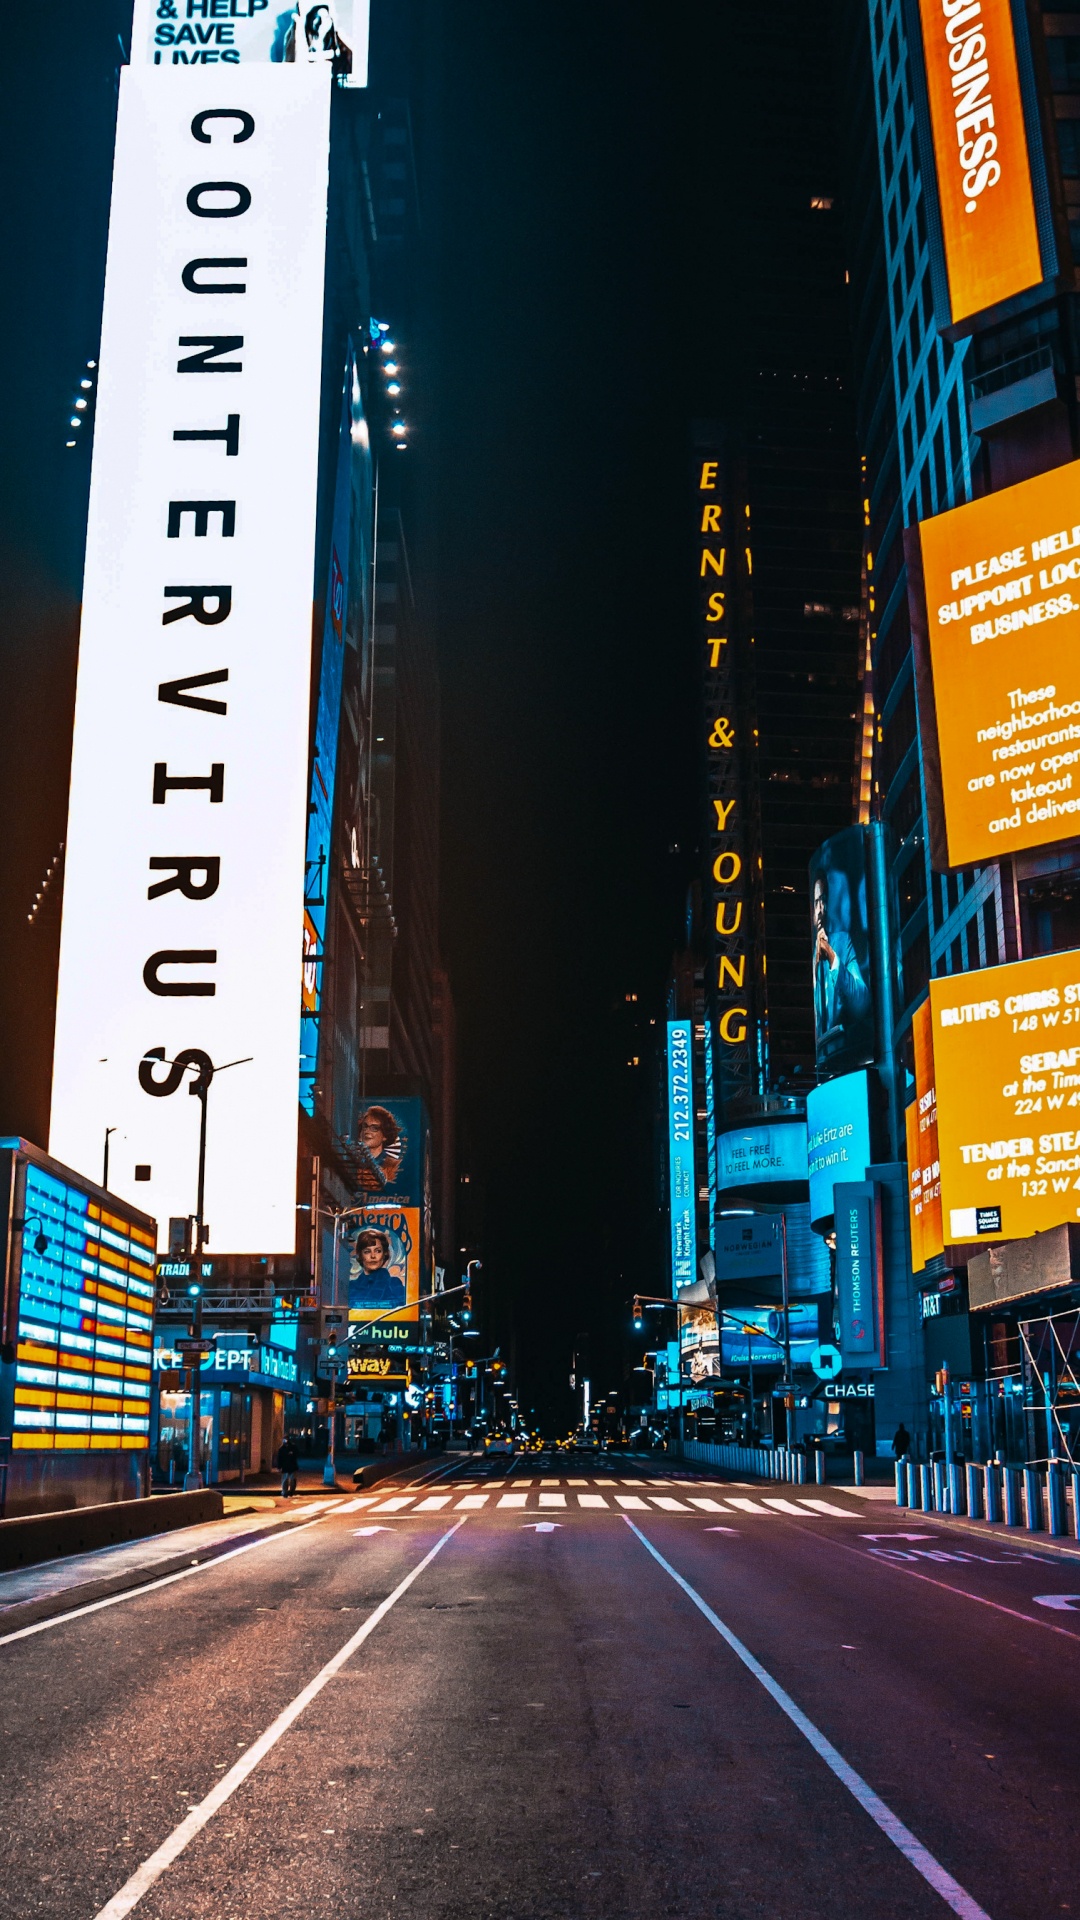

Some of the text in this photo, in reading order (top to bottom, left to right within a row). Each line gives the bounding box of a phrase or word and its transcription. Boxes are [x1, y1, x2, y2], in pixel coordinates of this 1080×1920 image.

[156, 0, 269, 19] & HELP
[154, 23, 235, 46] SAVE
[951, 546, 1027, 590] PLEASE
[938, 574, 1034, 625] SUPPORT
[970, 593, 1080, 645] BUSINESS.
[1007, 685, 1056, 709] These
[699, 462, 748, 1043] ERNST & YOUNG
[992, 723, 1080, 762] restaurants
[967, 774, 995, 792] are
[999, 761, 1036, 783] now
[1010, 773, 1072, 803] takeout
[988, 807, 1022, 833] and
[1012, 1014, 1038, 1033] 148
[1041, 1010, 1060, 1028] W
[672, 1029, 690, 1141] 212.372.2349
[1002, 1080, 1019, 1097] at
[1022, 1075, 1046, 1094] the
[1014, 1096, 1042, 1116] 224
[1046, 1093, 1064, 1111] W
[839, 1124, 853, 1138] are
[731, 1144, 770, 1159] FEEL FREE
[959, 1137, 1034, 1164] TENDER
[734, 1161, 750, 1172] FEEL
[753, 1156, 785, 1169] MORE.
[986, 1167, 1003, 1181] at
[1006, 1160, 1030, 1178] the
[1021, 1180, 1047, 1197] 132
[1052, 1177, 1070, 1194] W
[674, 1221, 682, 1257] Newmark
[682, 1209, 692, 1257] Knight Frank
[724, 1240, 772, 1252] NORWEGIAN
[850, 1209, 862, 1313] THOMSON REUTERS
[923, 1293, 941, 1318] AT&T
[372, 1326, 409, 1338] hulu
[347, 1358, 391, 1376] way
[825, 1384, 875, 1397] CHASE
[867, 1548, 1059, 1565] ONLY
